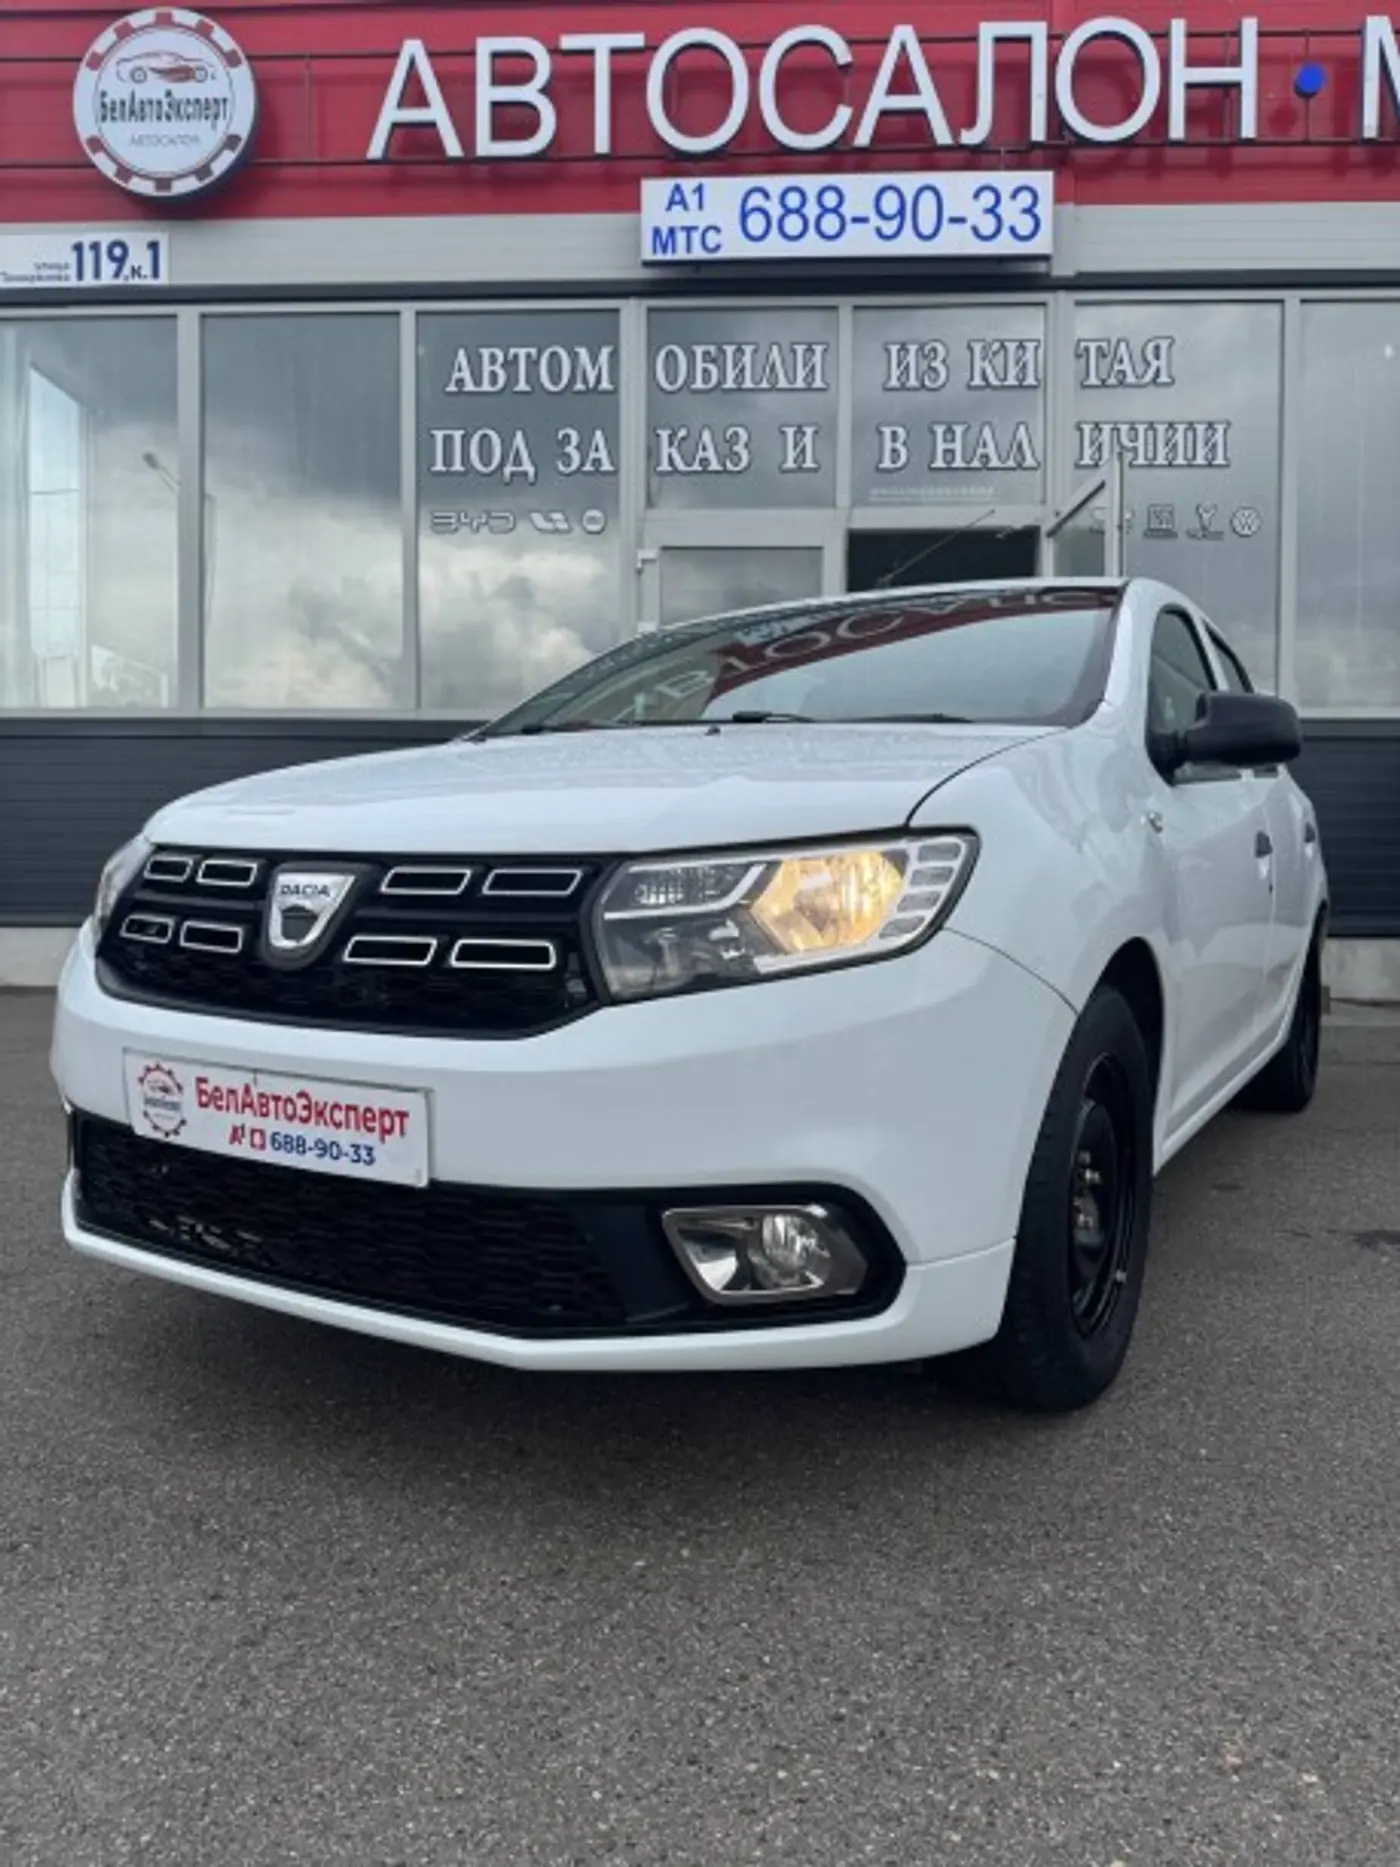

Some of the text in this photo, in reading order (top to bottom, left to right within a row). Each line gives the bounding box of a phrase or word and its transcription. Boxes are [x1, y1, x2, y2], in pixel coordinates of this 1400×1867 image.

[365, 17, 1258, 160] АВТОСАЛОН
[738, 184, 1042, 243] 688-90-33
[884, 339, 949, 390] ИЗ
[429, 428, 537, 485] ПОД
[780, 425, 821, 472] И
[877, 424, 909, 471] В
[195, 1076, 410, 1144] БелАвтоЭксперт
[270, 1130, 376, 1166] 688-90-33
